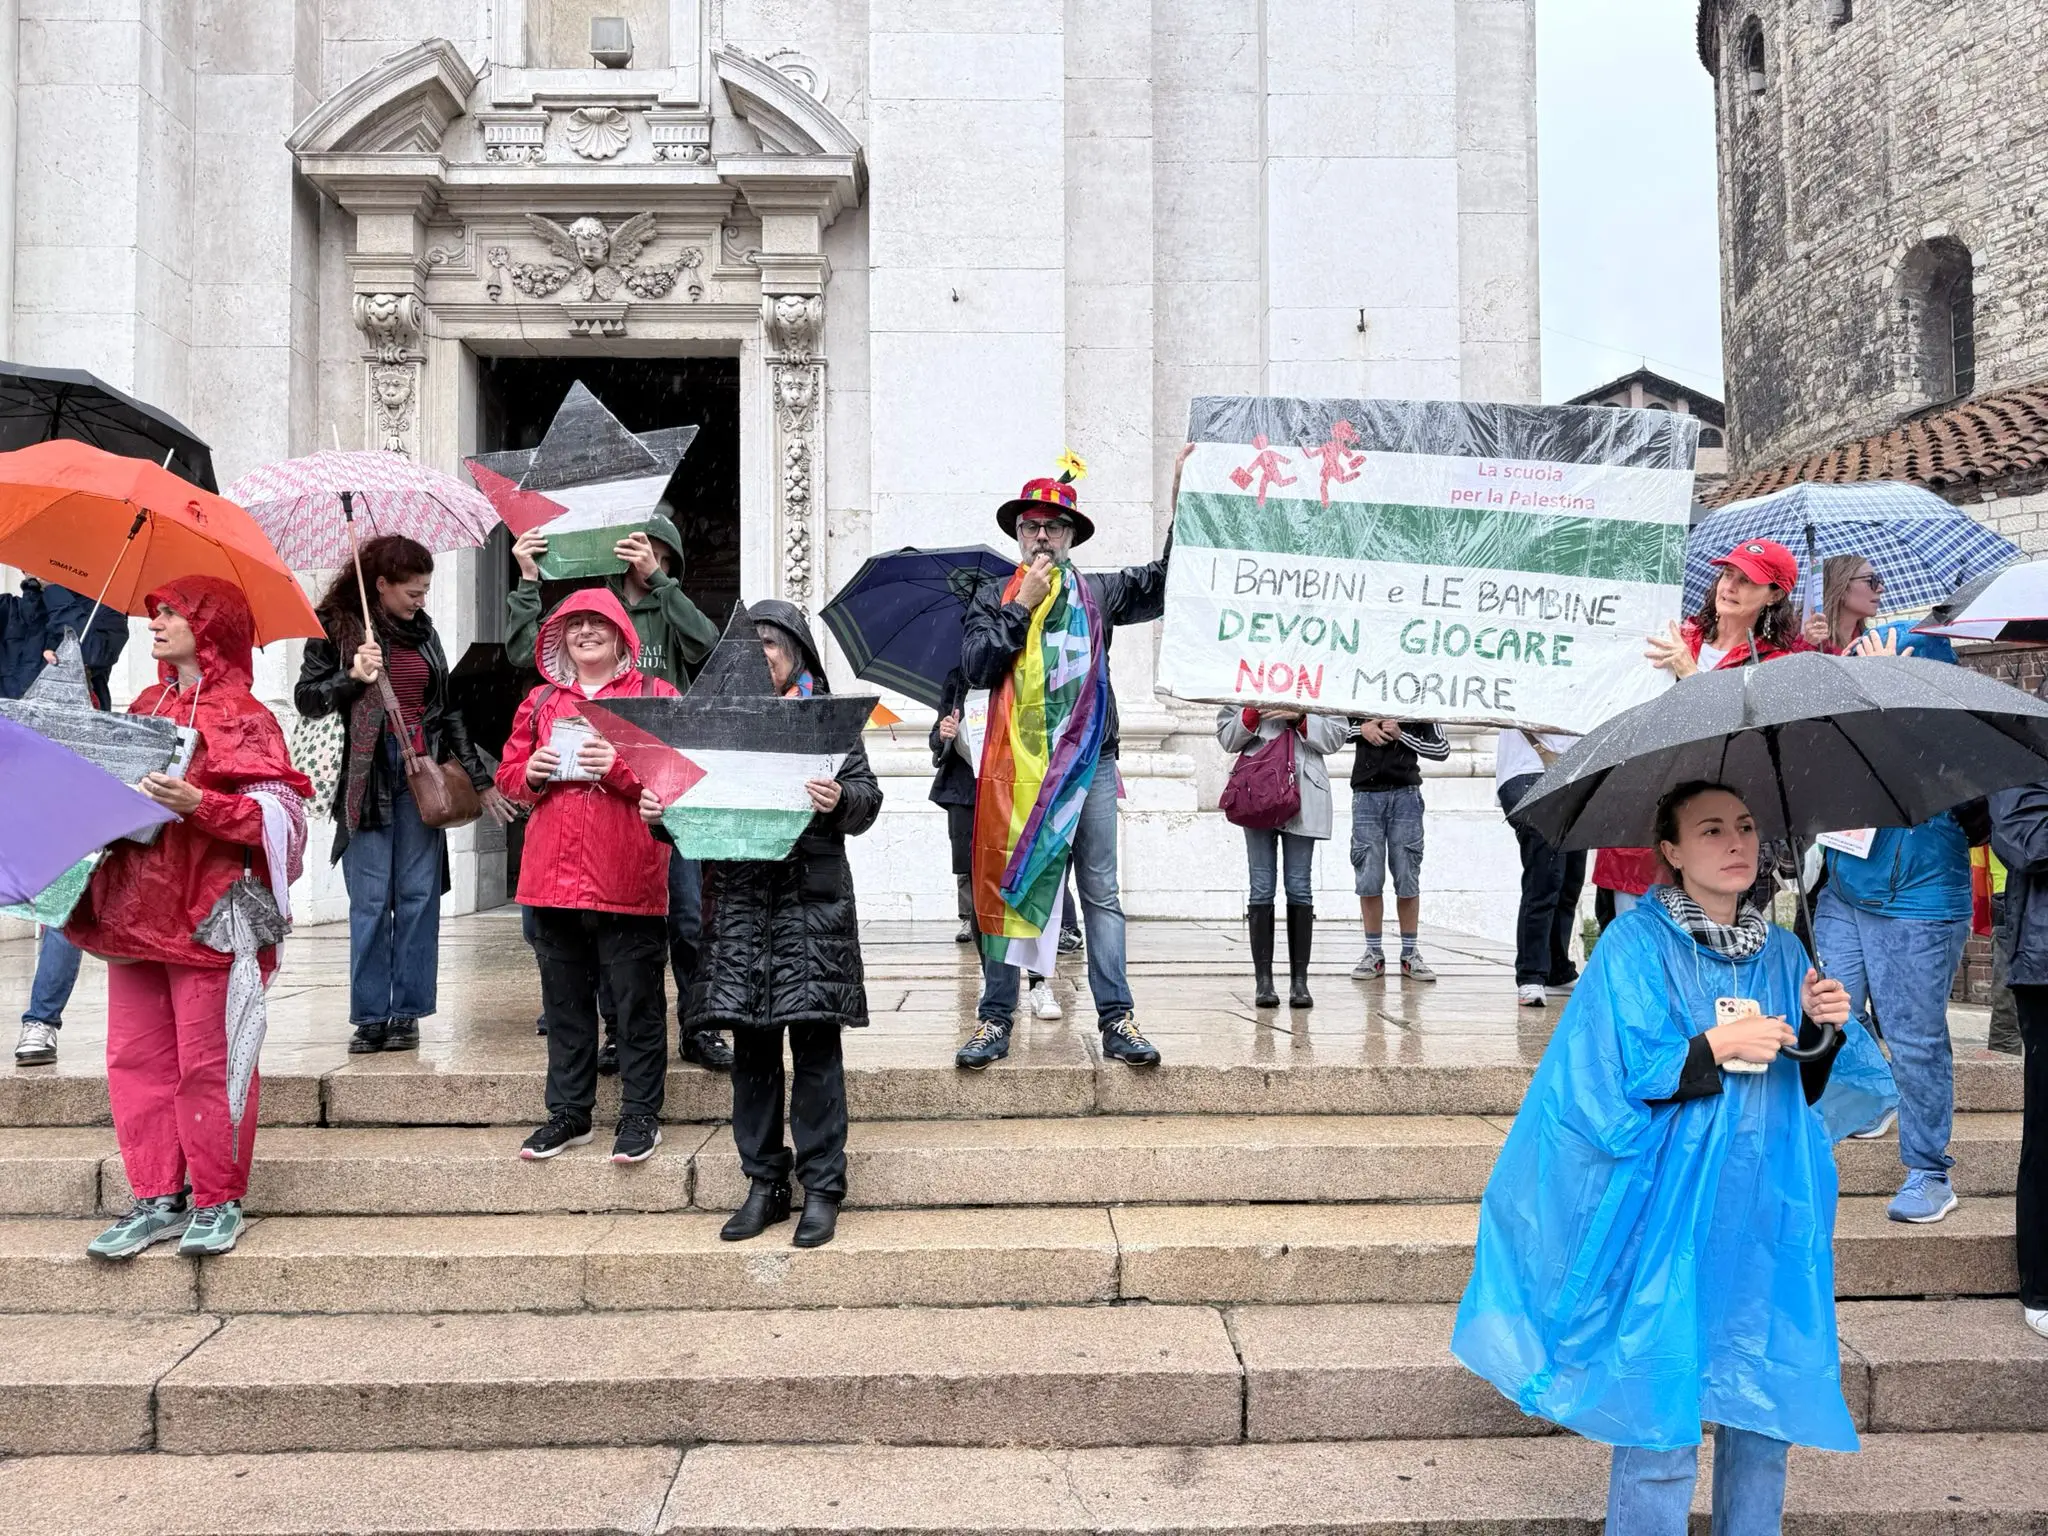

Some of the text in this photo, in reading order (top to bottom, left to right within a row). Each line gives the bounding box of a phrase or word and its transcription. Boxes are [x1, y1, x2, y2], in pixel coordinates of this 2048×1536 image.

[1451, 488, 1596, 510] per la Palestina
[1478, 462, 1564, 482] La scuola
[1211, 557, 1622, 626] I BAMBINI e LE BAMBINE
[1218, 608, 1575, 667] DEVON GIOCARE
[1235, 658, 1517, 712] NON MORIRE
